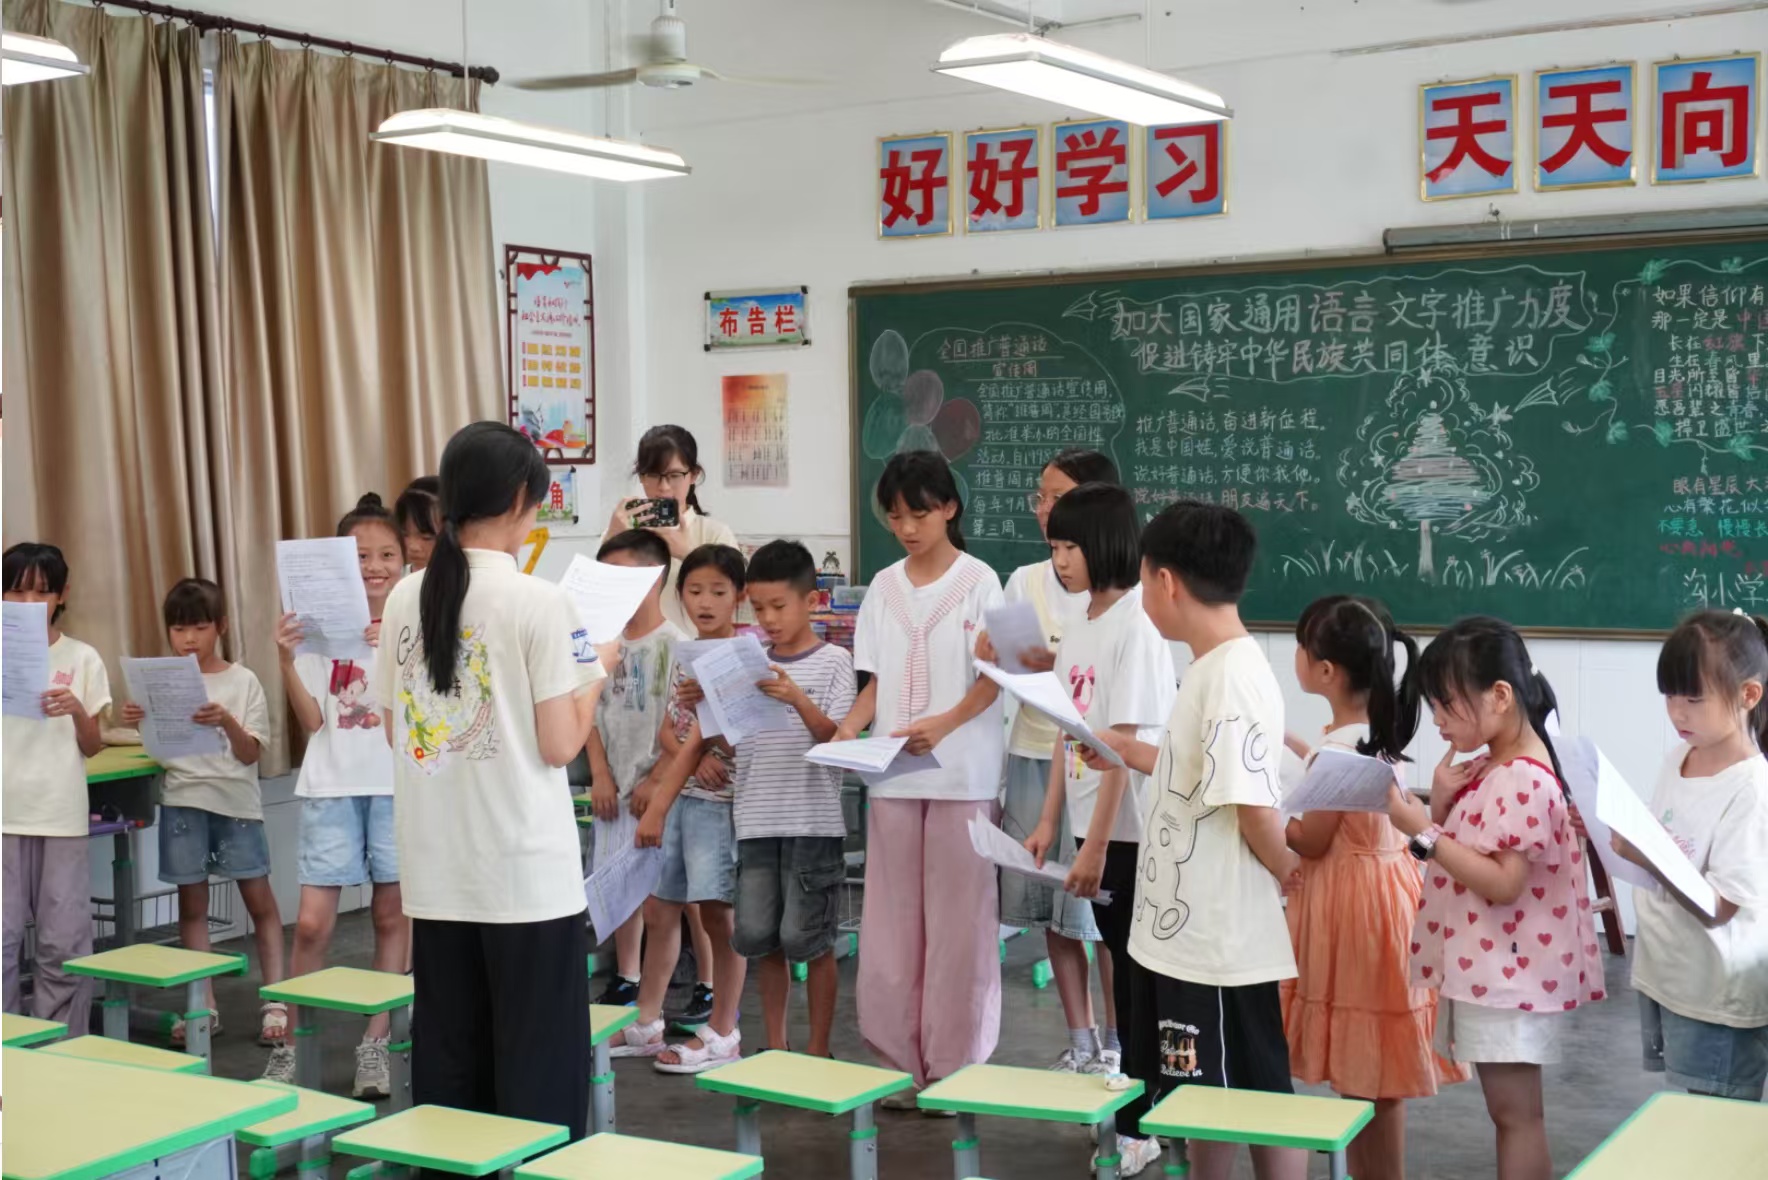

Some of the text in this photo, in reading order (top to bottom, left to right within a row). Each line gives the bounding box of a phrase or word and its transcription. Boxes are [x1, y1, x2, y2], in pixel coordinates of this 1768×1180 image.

[879, 122, 1220, 229] 好好学习
[719, 304, 797, 338] 布告栏
[1112, 280, 1587, 338] 加大国家通用语言文字推广力度
[1136, 332, 1538, 381] 促进铸牢中华民族共同体意识
